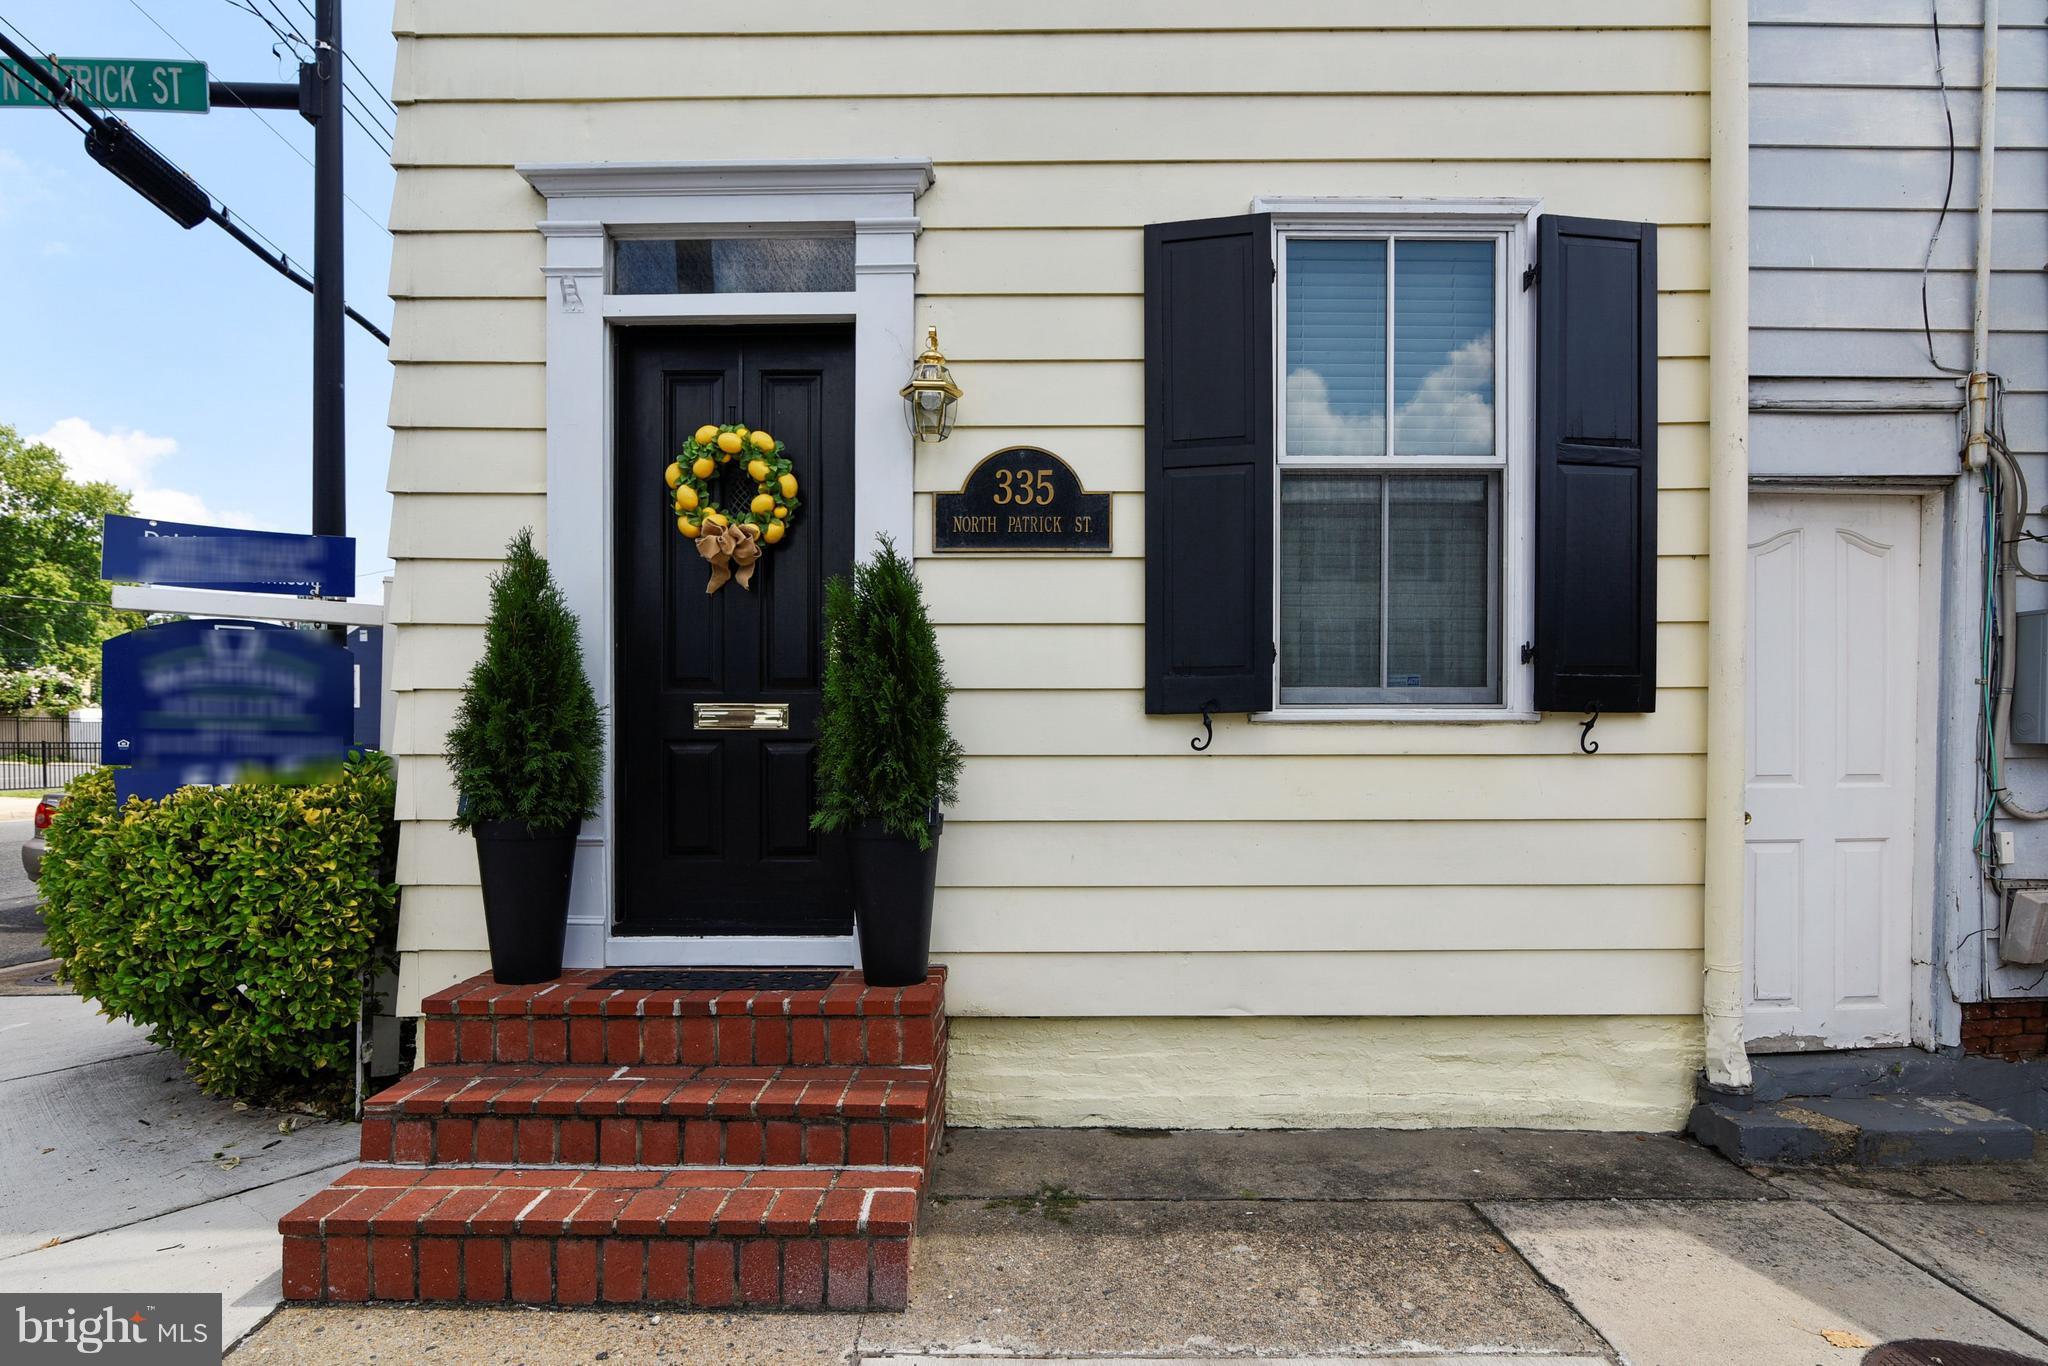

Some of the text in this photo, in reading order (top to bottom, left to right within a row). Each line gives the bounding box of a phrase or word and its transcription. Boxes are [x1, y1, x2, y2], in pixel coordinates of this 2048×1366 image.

[3, 65, 19, 100] N
[152, 67, 182, 105] ST
[993, 469, 1055, 505] 335
[953, 516, 1093, 533] NORTH PATRICK ST.
